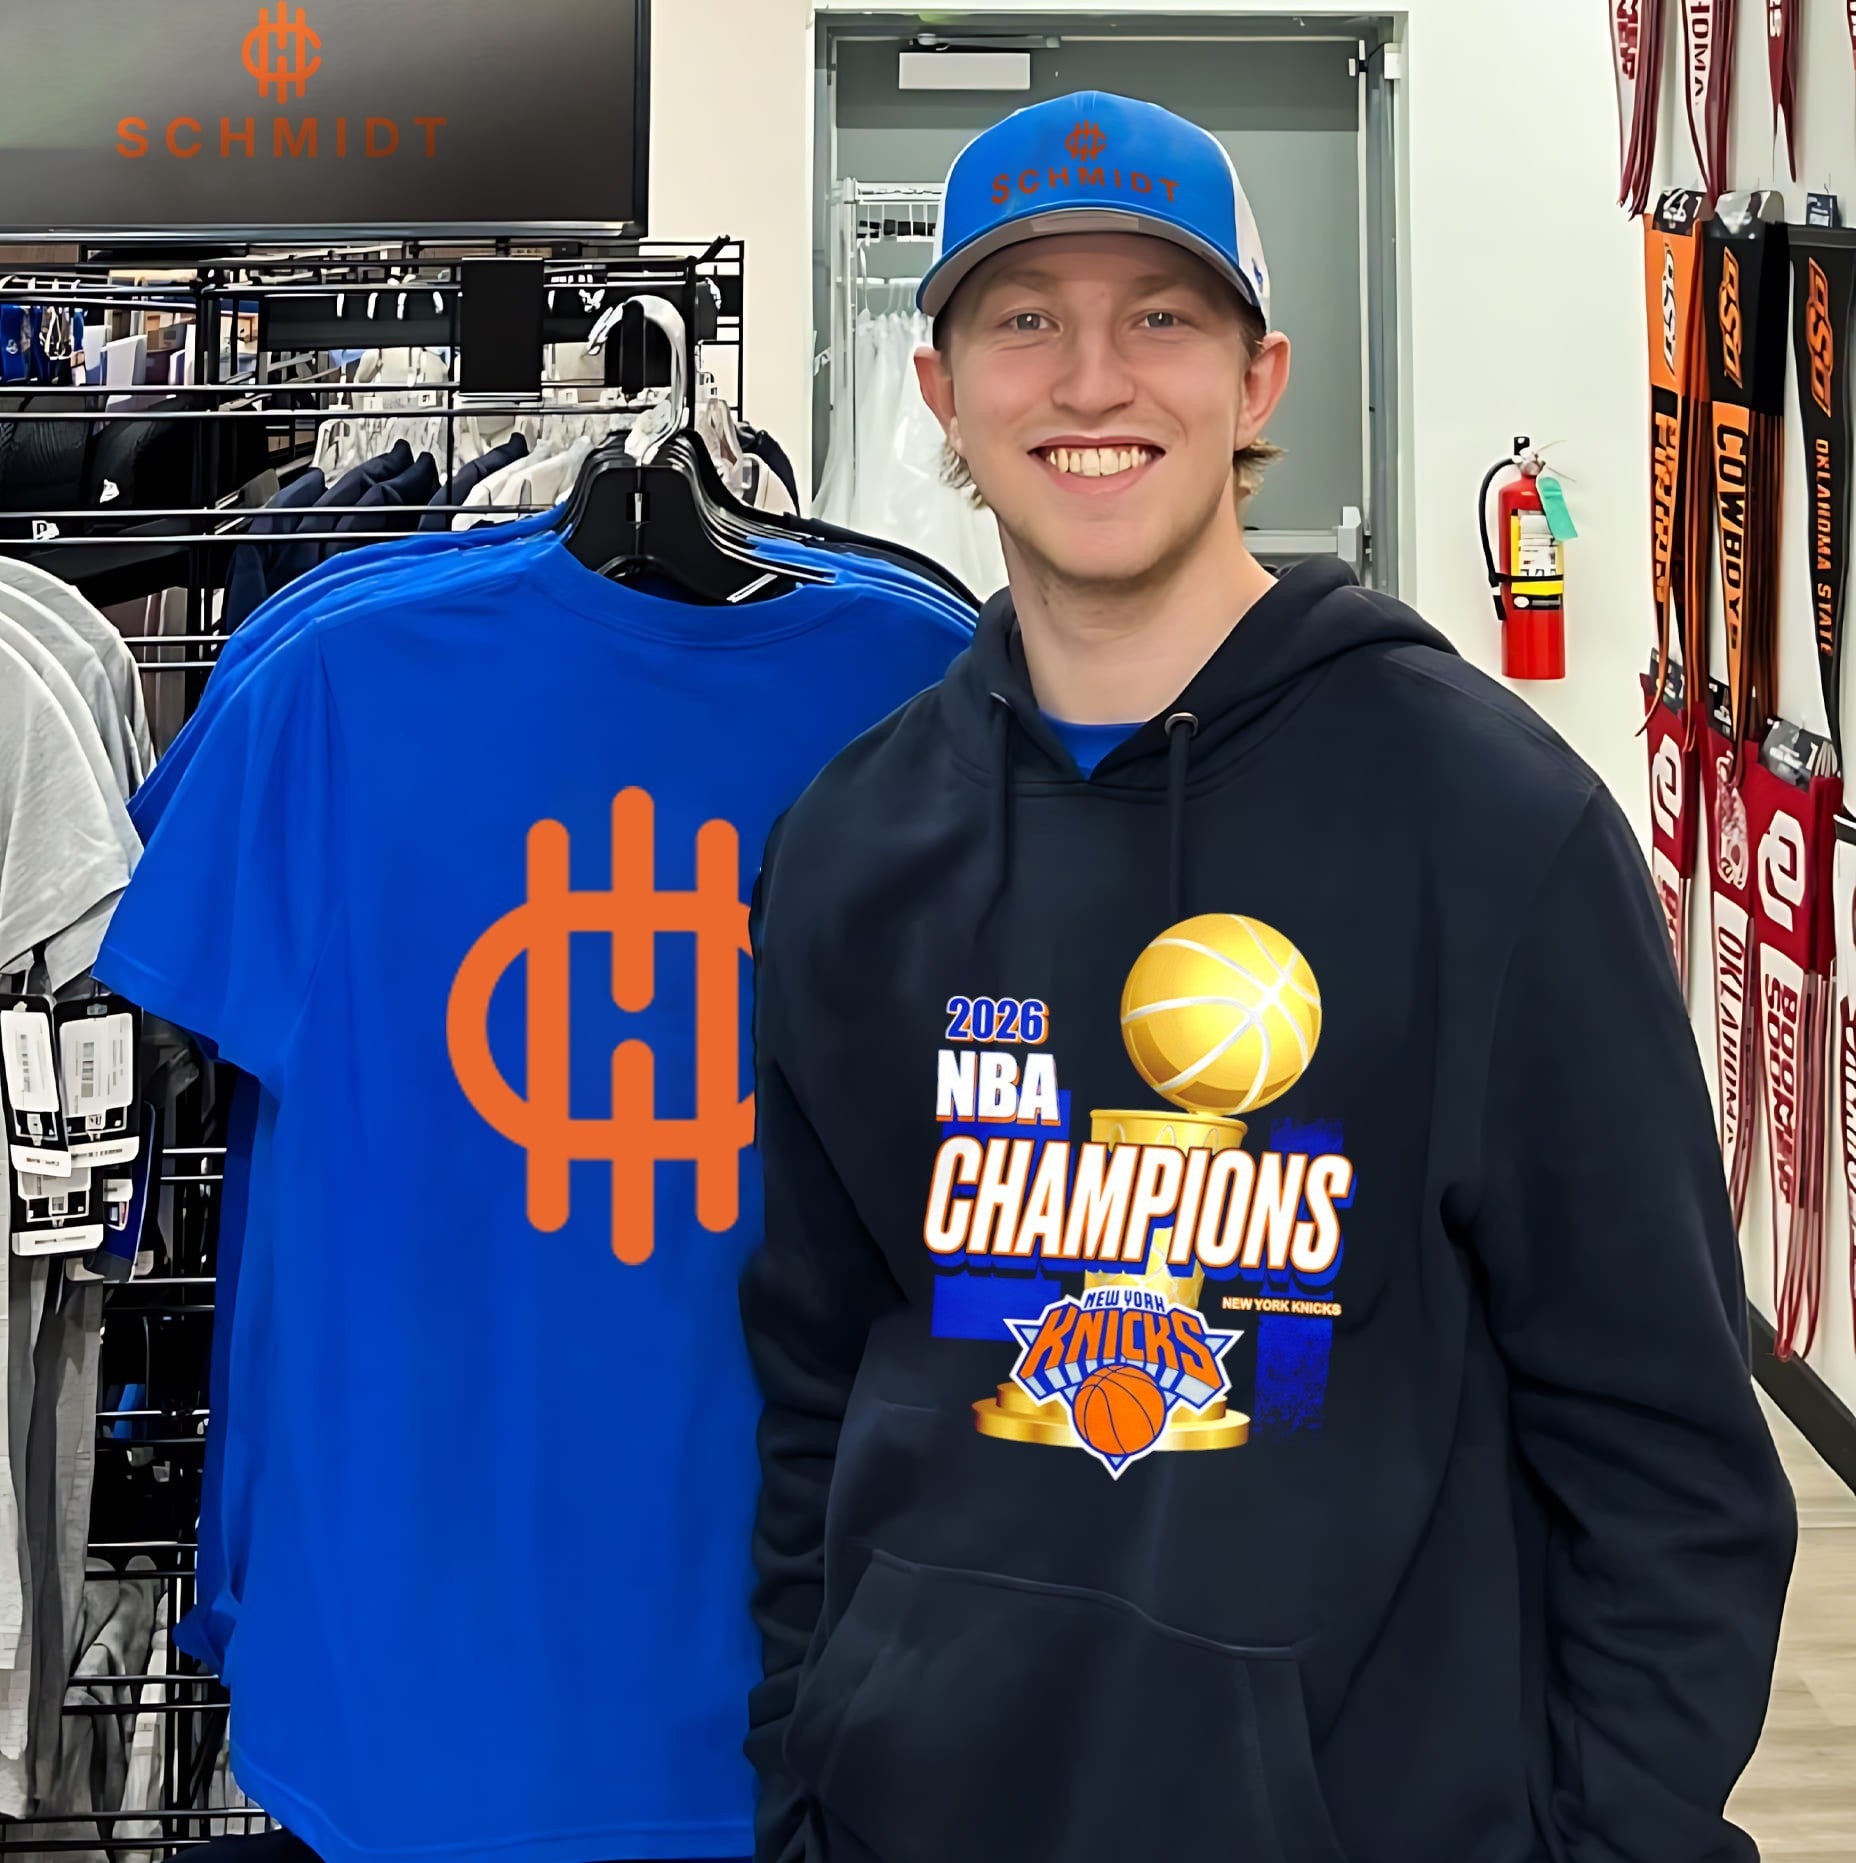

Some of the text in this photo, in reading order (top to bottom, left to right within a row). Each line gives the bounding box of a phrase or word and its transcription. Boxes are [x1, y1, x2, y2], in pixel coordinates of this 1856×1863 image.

[115, 116, 448, 158] SCHMIDT
[991, 167, 1180, 205] SCHMIDT
[1815, 438, 1832, 570] OKLAHOMA
[945, 995, 1050, 1045] 2026
[936, 1049, 1061, 1126] NBA
[923, 1135, 1355, 1276] CHAMPIONS
[1083, 1289, 1166, 1313] NEW YORK
[1221, 1296, 1342, 1317] NEW YORK KNICKS
[1019, 1304, 1222, 1389] KNICKS
